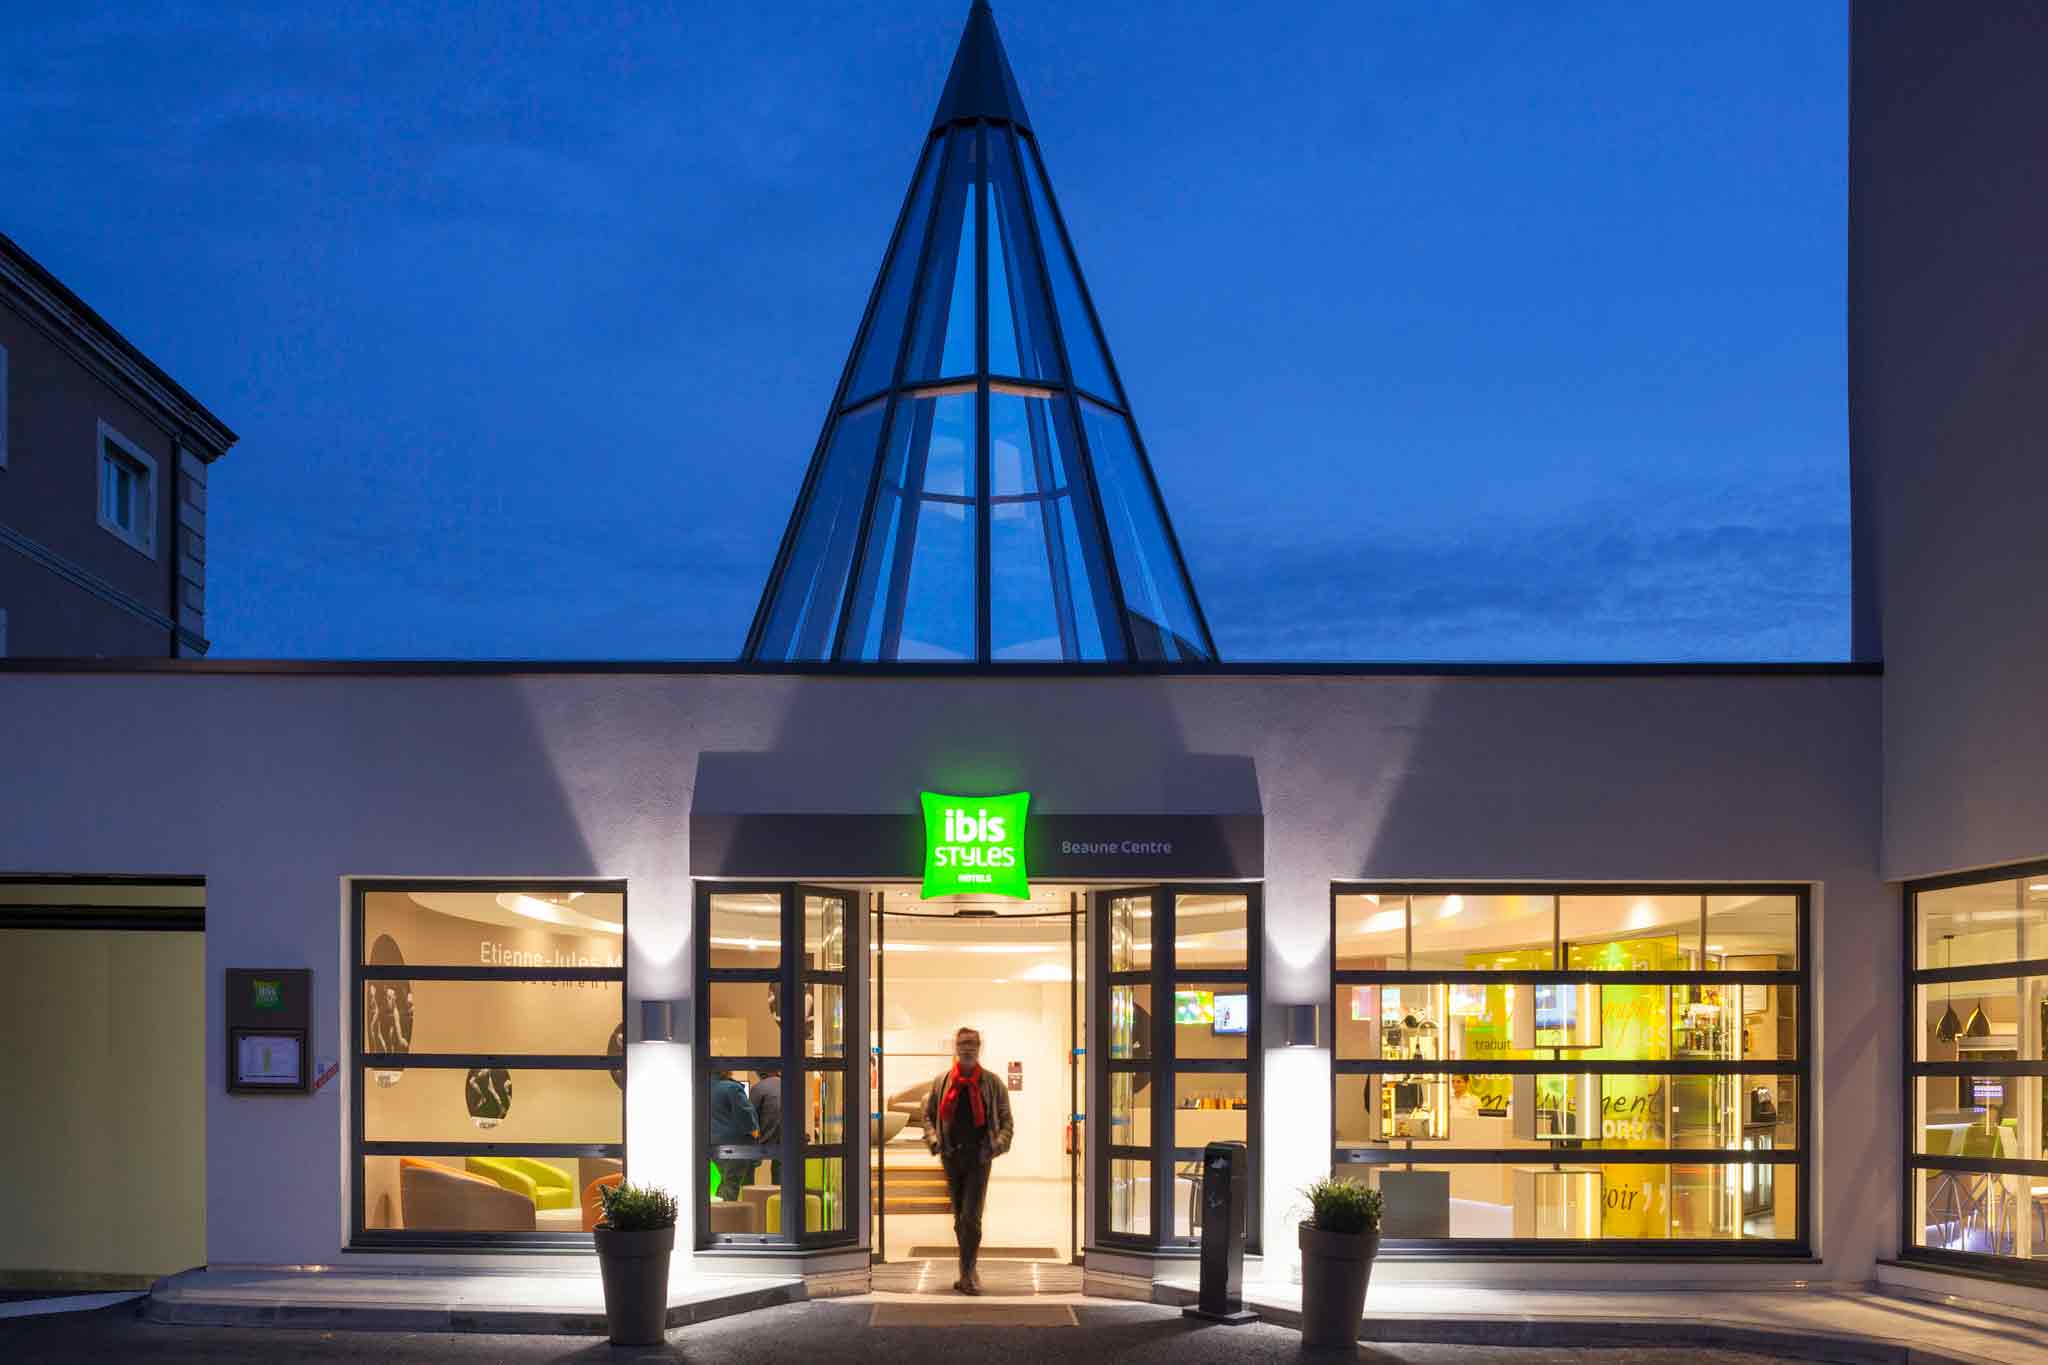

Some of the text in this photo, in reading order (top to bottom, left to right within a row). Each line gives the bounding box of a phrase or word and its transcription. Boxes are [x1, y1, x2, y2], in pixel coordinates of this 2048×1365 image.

[945, 809, 1005, 842] ibis
[1061, 841, 1173, 854] Beaune Centre
